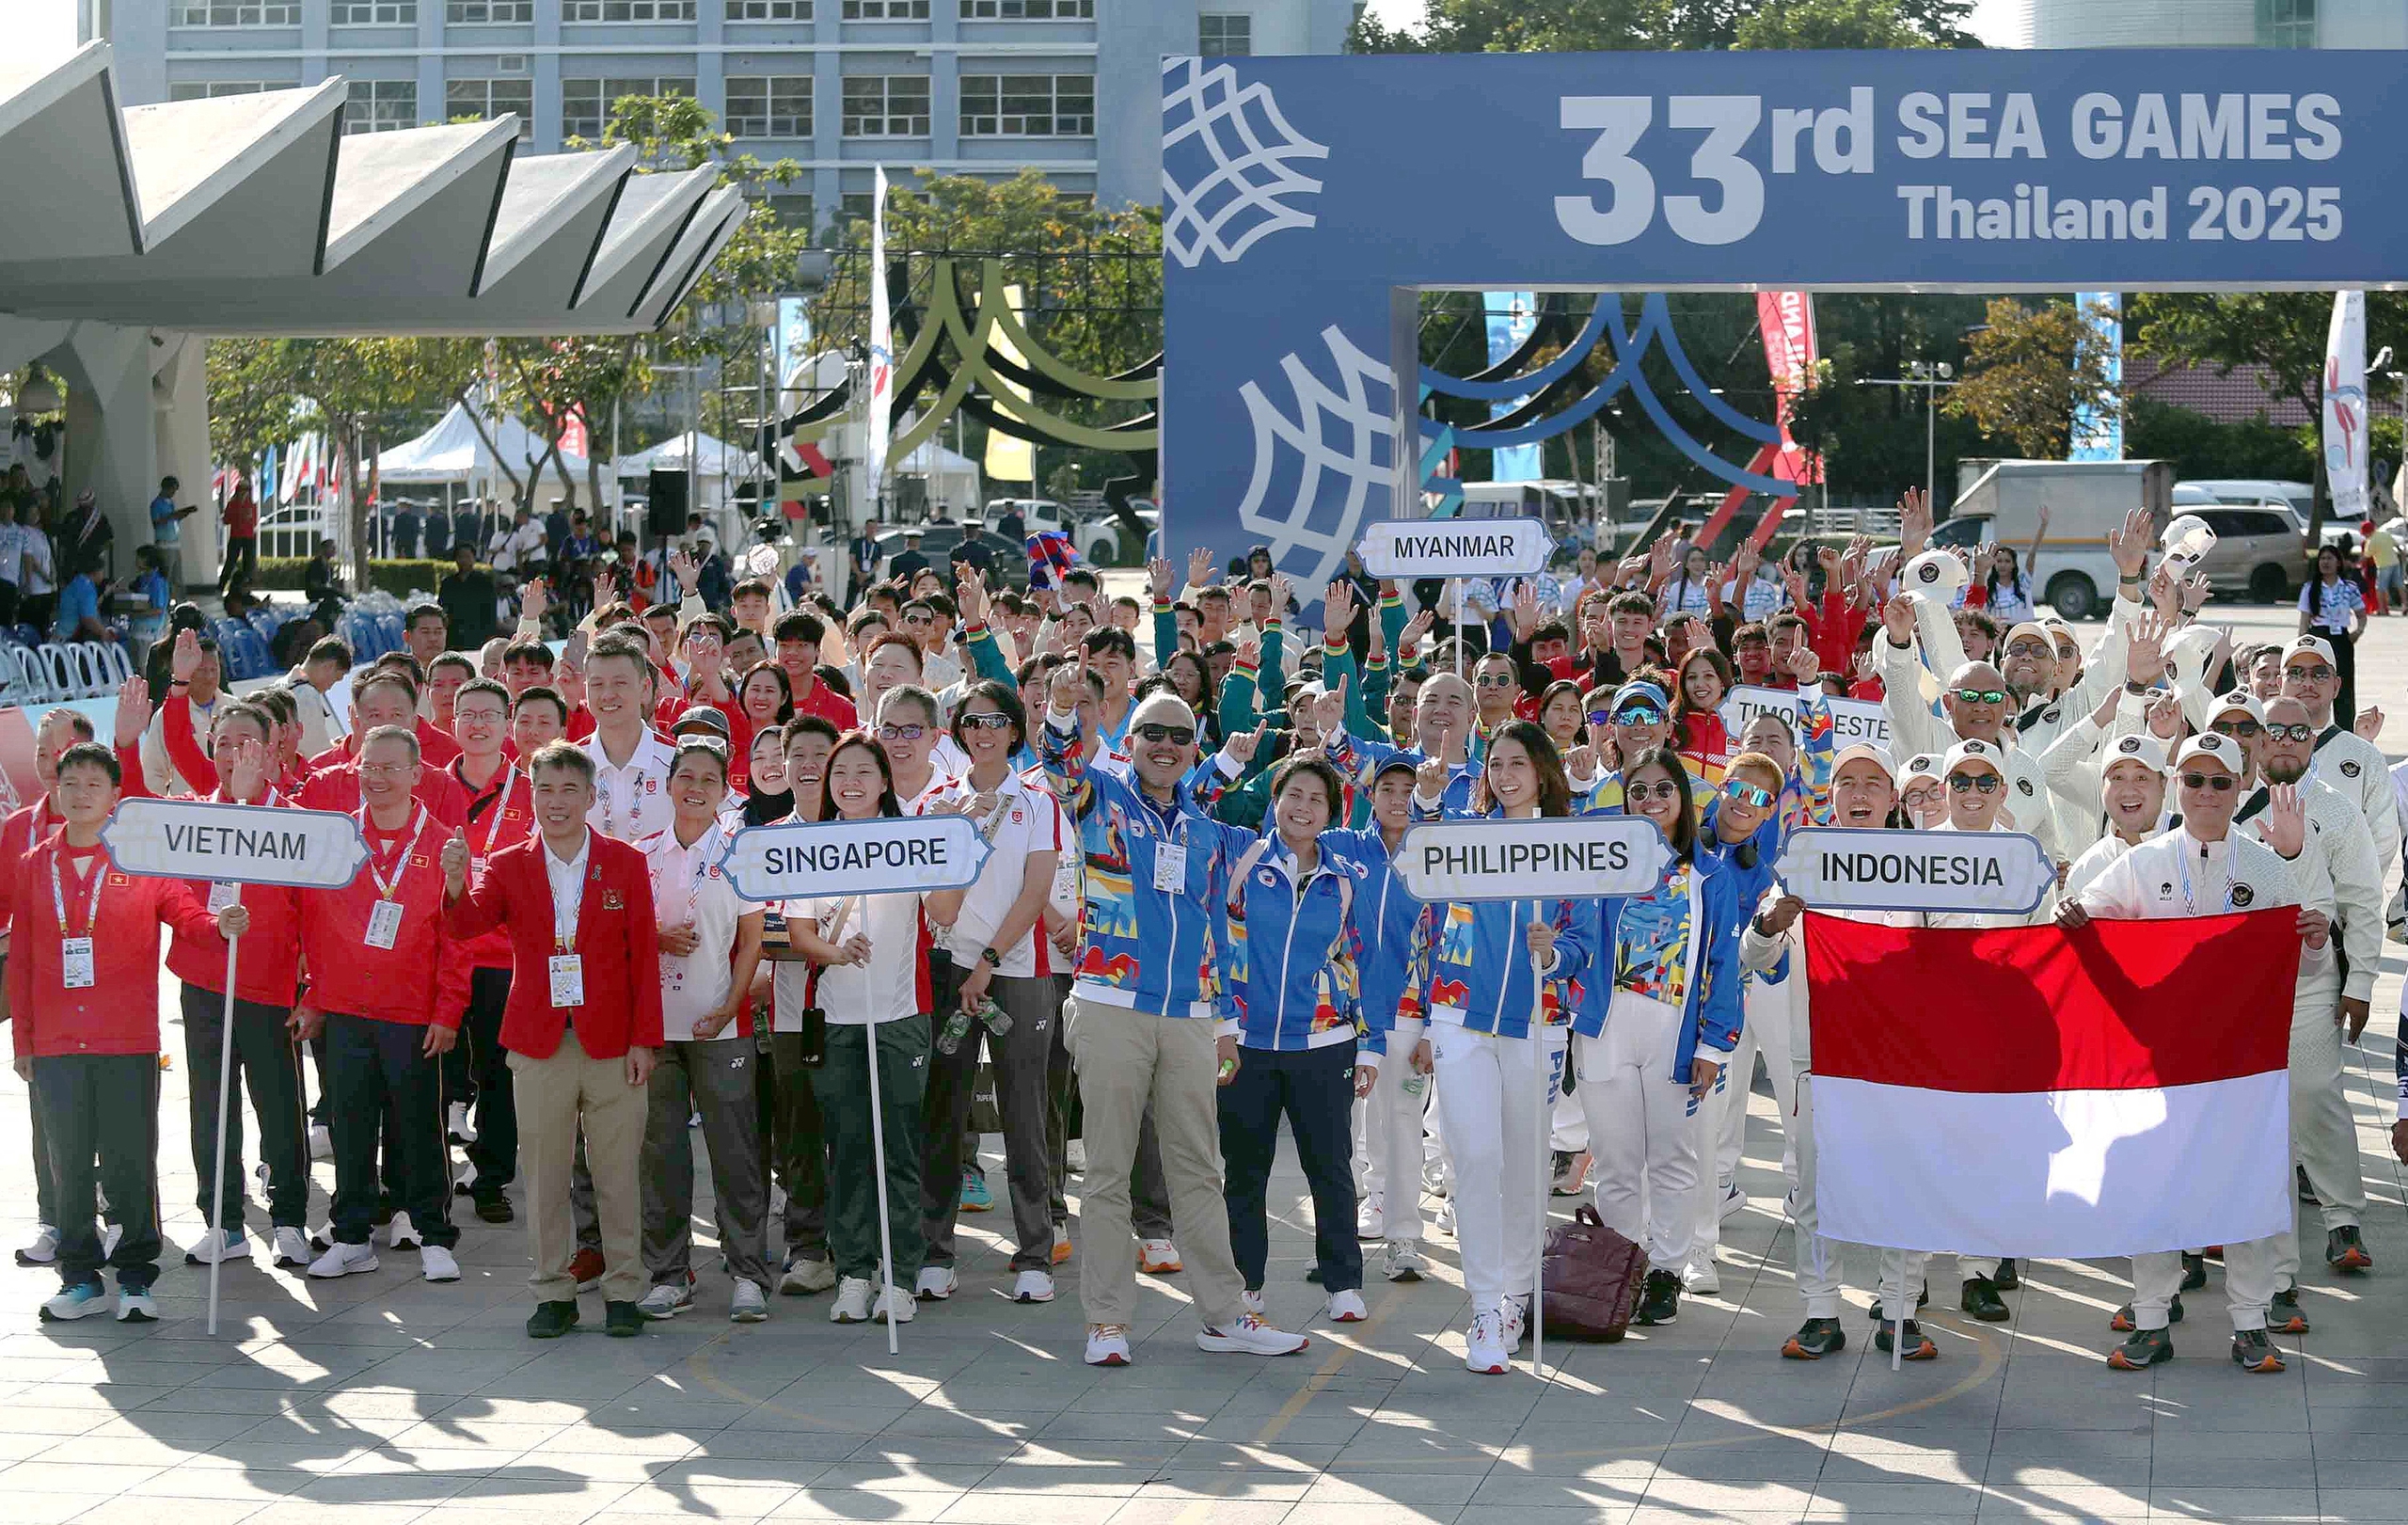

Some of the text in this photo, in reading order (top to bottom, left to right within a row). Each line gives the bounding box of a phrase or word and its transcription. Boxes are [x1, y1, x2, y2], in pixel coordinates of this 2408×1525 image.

[1553, 86, 2343, 246] 33rd SEA GAMES
[1896, 183, 2343, 242] Thailand 2025
[1395, 535, 1514, 558] MYANMAR
[164, 823, 307, 861] VIETNAM
[765, 837, 947, 875] SINGAPORE
[1424, 841, 1628, 875] PHILIPPINES
[1822, 852, 2004, 886] INDONESIA
